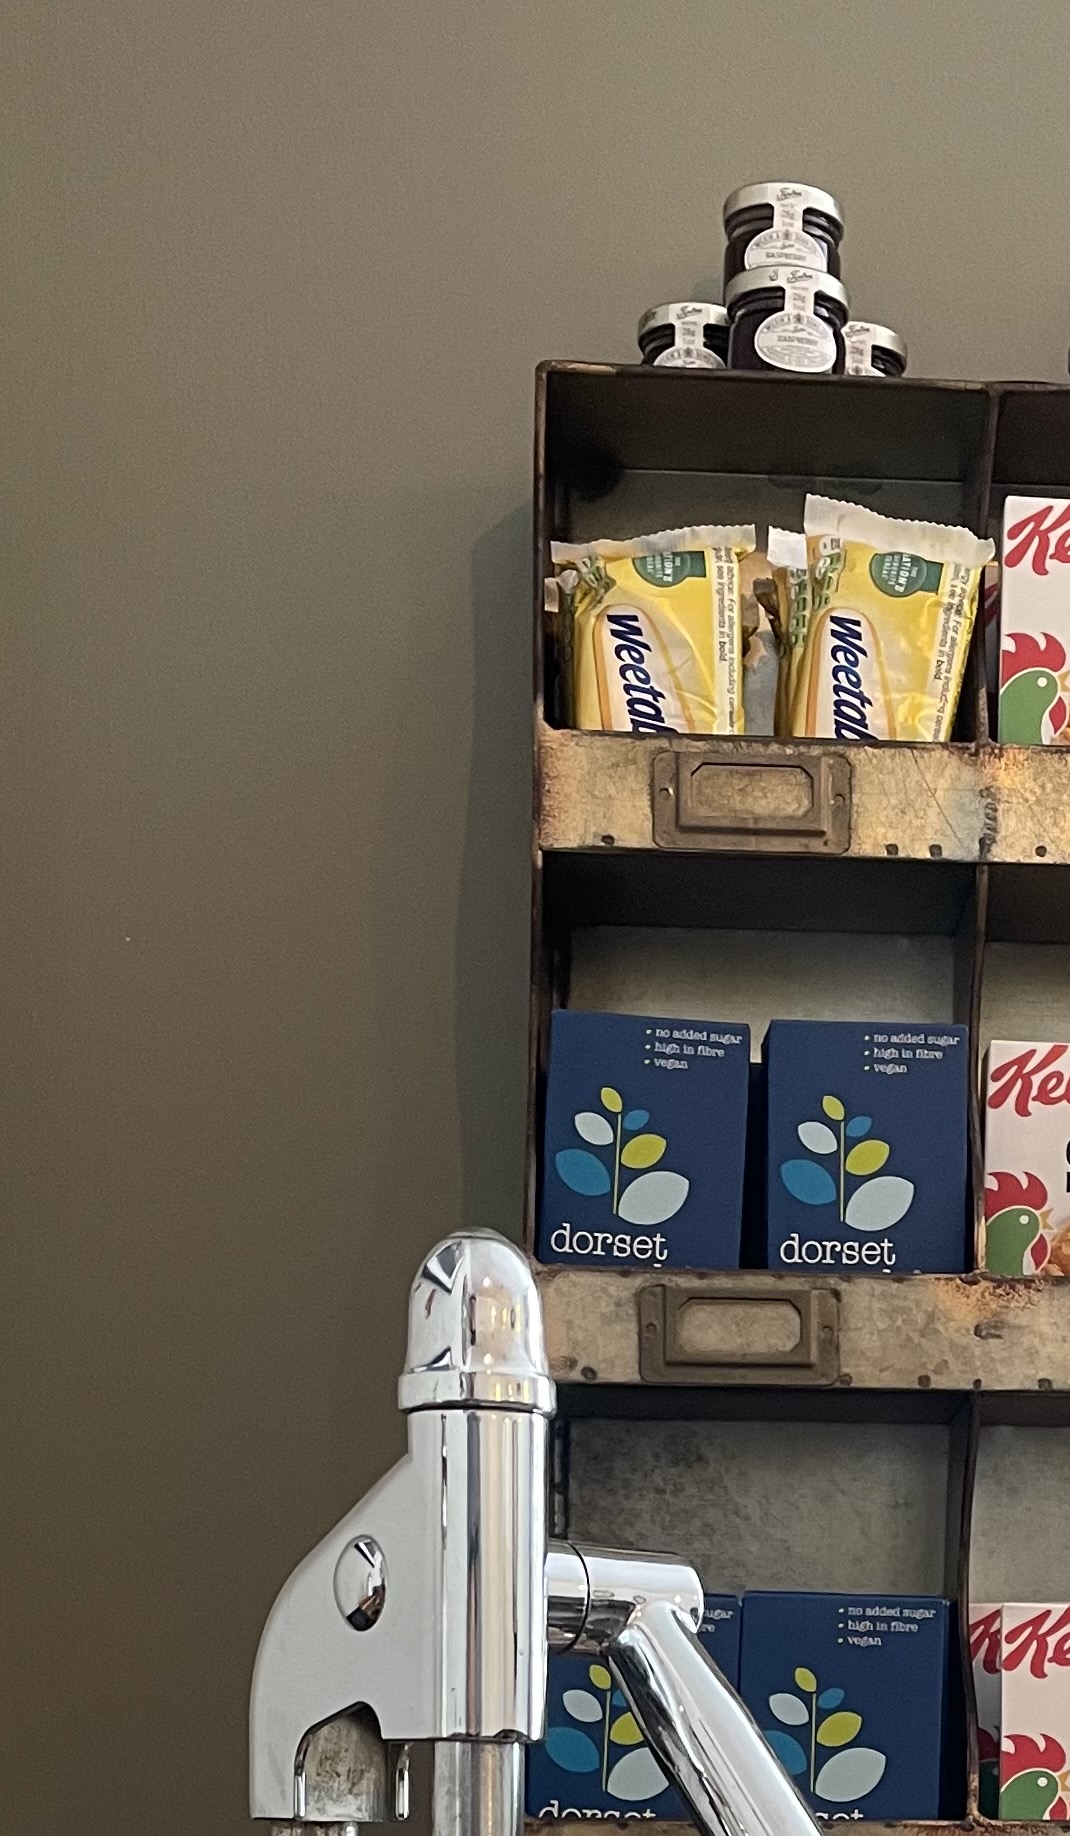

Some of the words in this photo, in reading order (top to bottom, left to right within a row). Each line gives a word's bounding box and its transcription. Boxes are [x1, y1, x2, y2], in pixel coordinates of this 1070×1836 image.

[662, 552, 673, 582] TION'S
[894, 553, 912, 592] ATION'S
[606, 614, 679, 733] Weetab
[829, 615, 879, 740] Weetab
[655, 1029, 671, 1038] no
[672, 1029, 707, 1041] added
[709, 1033, 743, 1045] sugar
[873, 1034, 889, 1043] no
[890, 1033, 925, 1044] added
[927, 1035, 961, 1047] sugar
[654, 1041, 680, 1055] high
[683, 1044, 695, 1055] in
[697, 1045, 725, 1057] fibre
[873, 1047, 899, 1060] high
[901, 1048, 913, 1058] in
[915, 1048, 944, 1060] fibre
[653, 1058, 688, 1070] vegan
[873, 1063, 908, 1075] vegan
[550, 1223, 668, 1261] dorset
[780, 1233, 896, 1266] dorset
[848, 1606, 863, 1616] no
[865, 1605, 901, 1617] added
[902, 1608, 937, 1620] sugar
[847, 1620, 874, 1633] high
[876, 1621, 888, 1632] in
[890, 1621, 919, 1632] fibre
[847, 1636, 882, 1647] vegan
